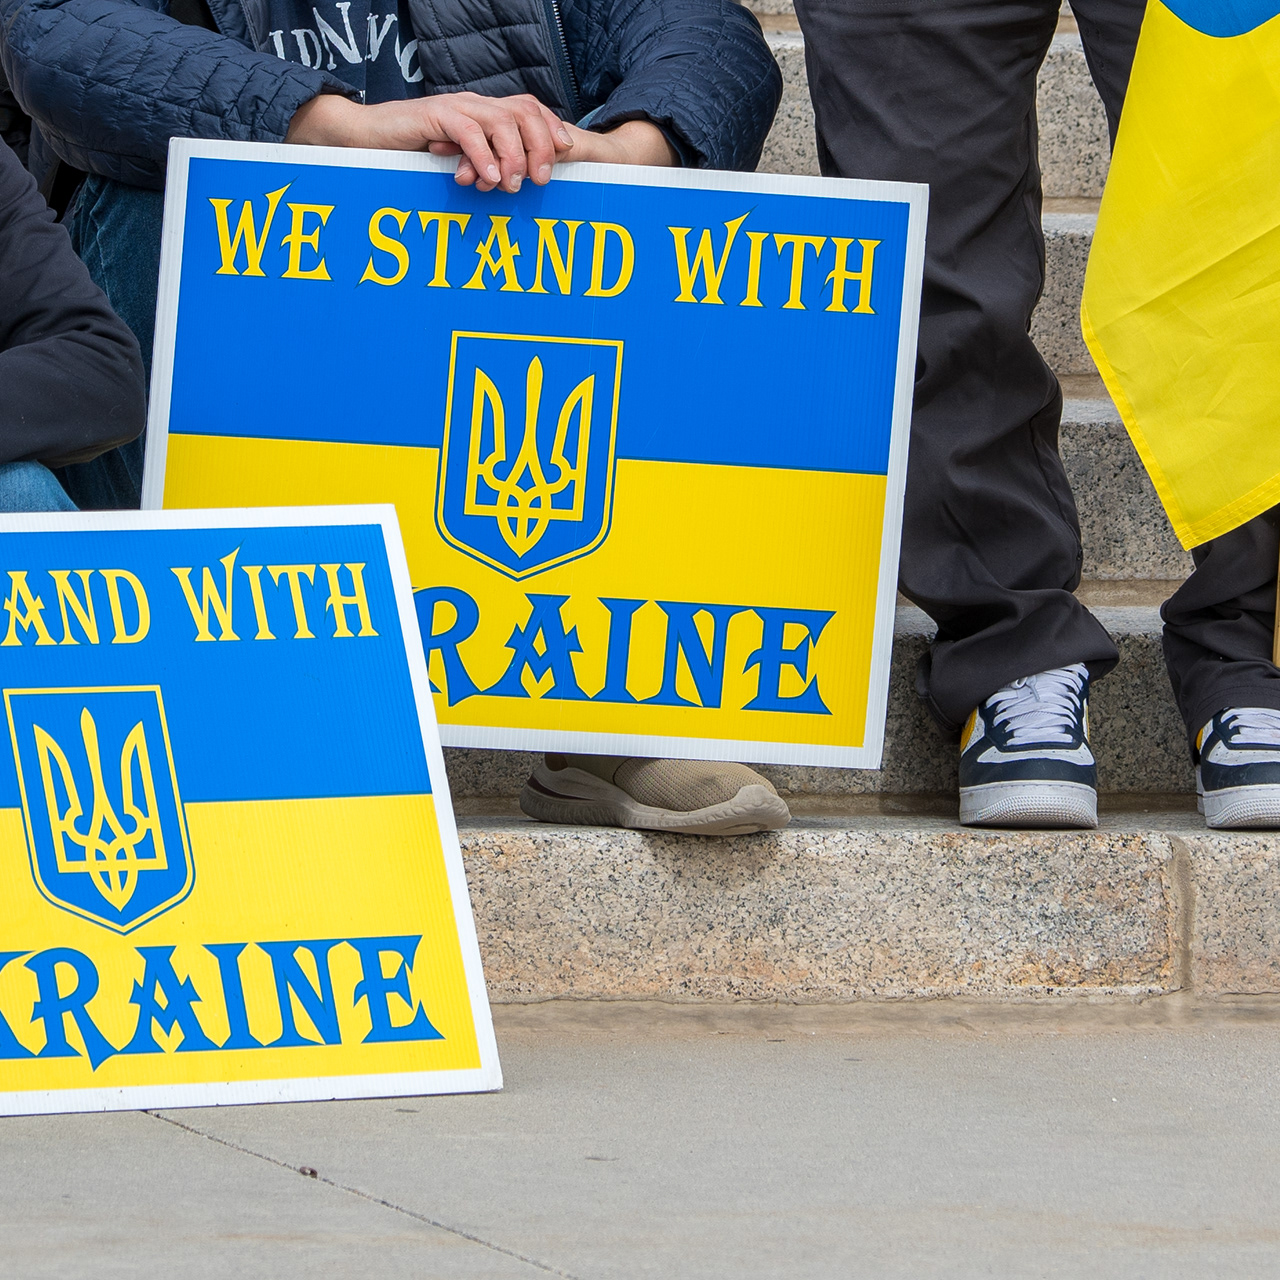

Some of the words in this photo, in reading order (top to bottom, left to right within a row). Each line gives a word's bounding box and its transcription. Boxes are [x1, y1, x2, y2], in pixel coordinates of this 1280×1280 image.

[207, 179, 336, 283] WE
[355, 206, 637, 299] STAND
[668, 208, 884, 316] WITH
[169, 547, 381, 643] WITH
[412, 583, 838, 717] RAINE
